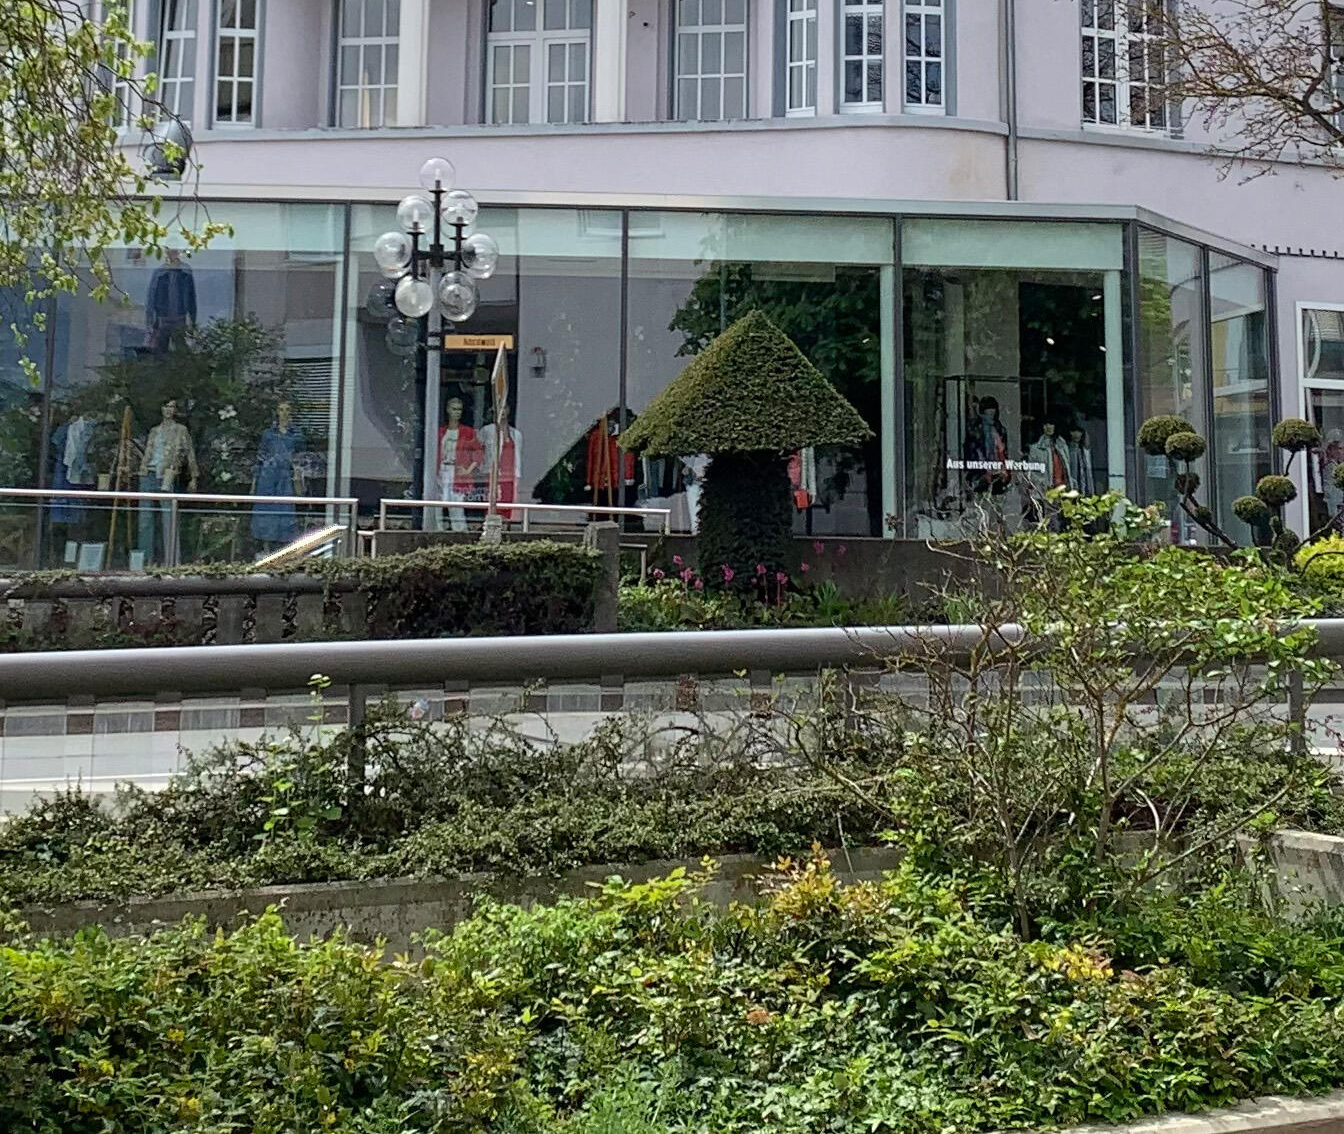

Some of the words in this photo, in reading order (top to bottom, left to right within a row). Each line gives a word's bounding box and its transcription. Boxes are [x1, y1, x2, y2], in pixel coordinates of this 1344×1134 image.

[946, 458, 964, 470] Aus
[966, 460, 1003, 471] unserer
[1004, 459, 1046, 474] Werbung
